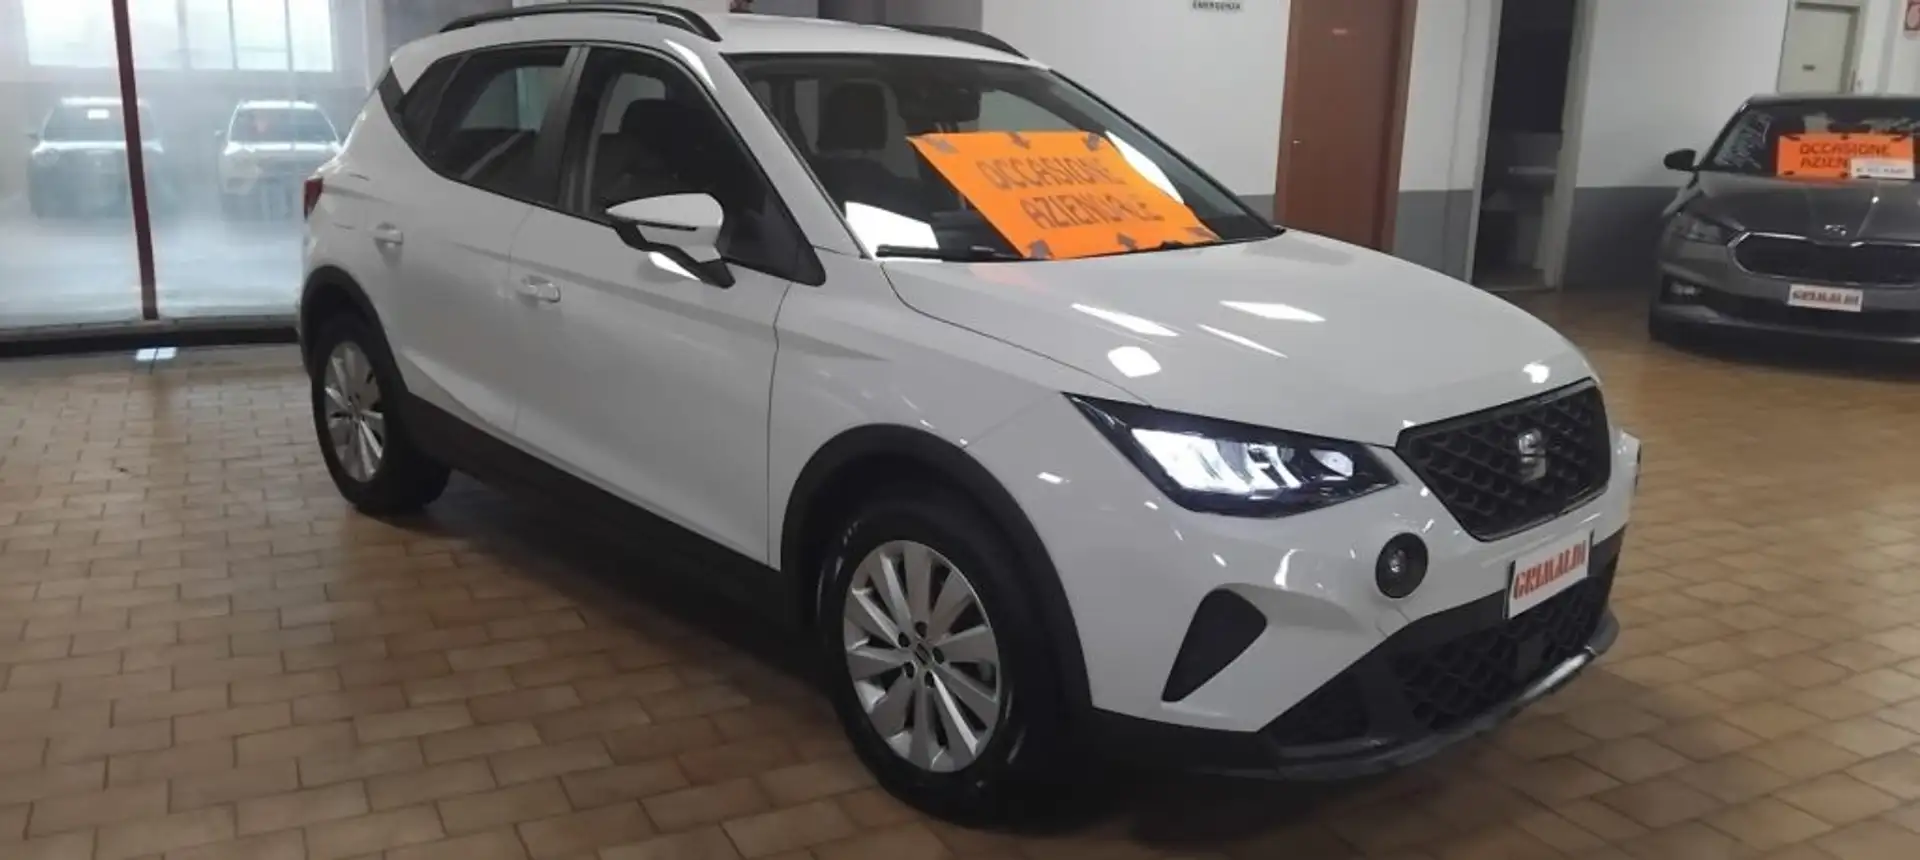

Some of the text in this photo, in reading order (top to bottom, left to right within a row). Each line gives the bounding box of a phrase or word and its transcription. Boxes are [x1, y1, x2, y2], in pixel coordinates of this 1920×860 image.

[1799, 143, 1889, 156] OCCASIONE
[977, 156, 1127, 189] OCCASIONE
[1513, 540, 1586, 600] GRIMALDI
